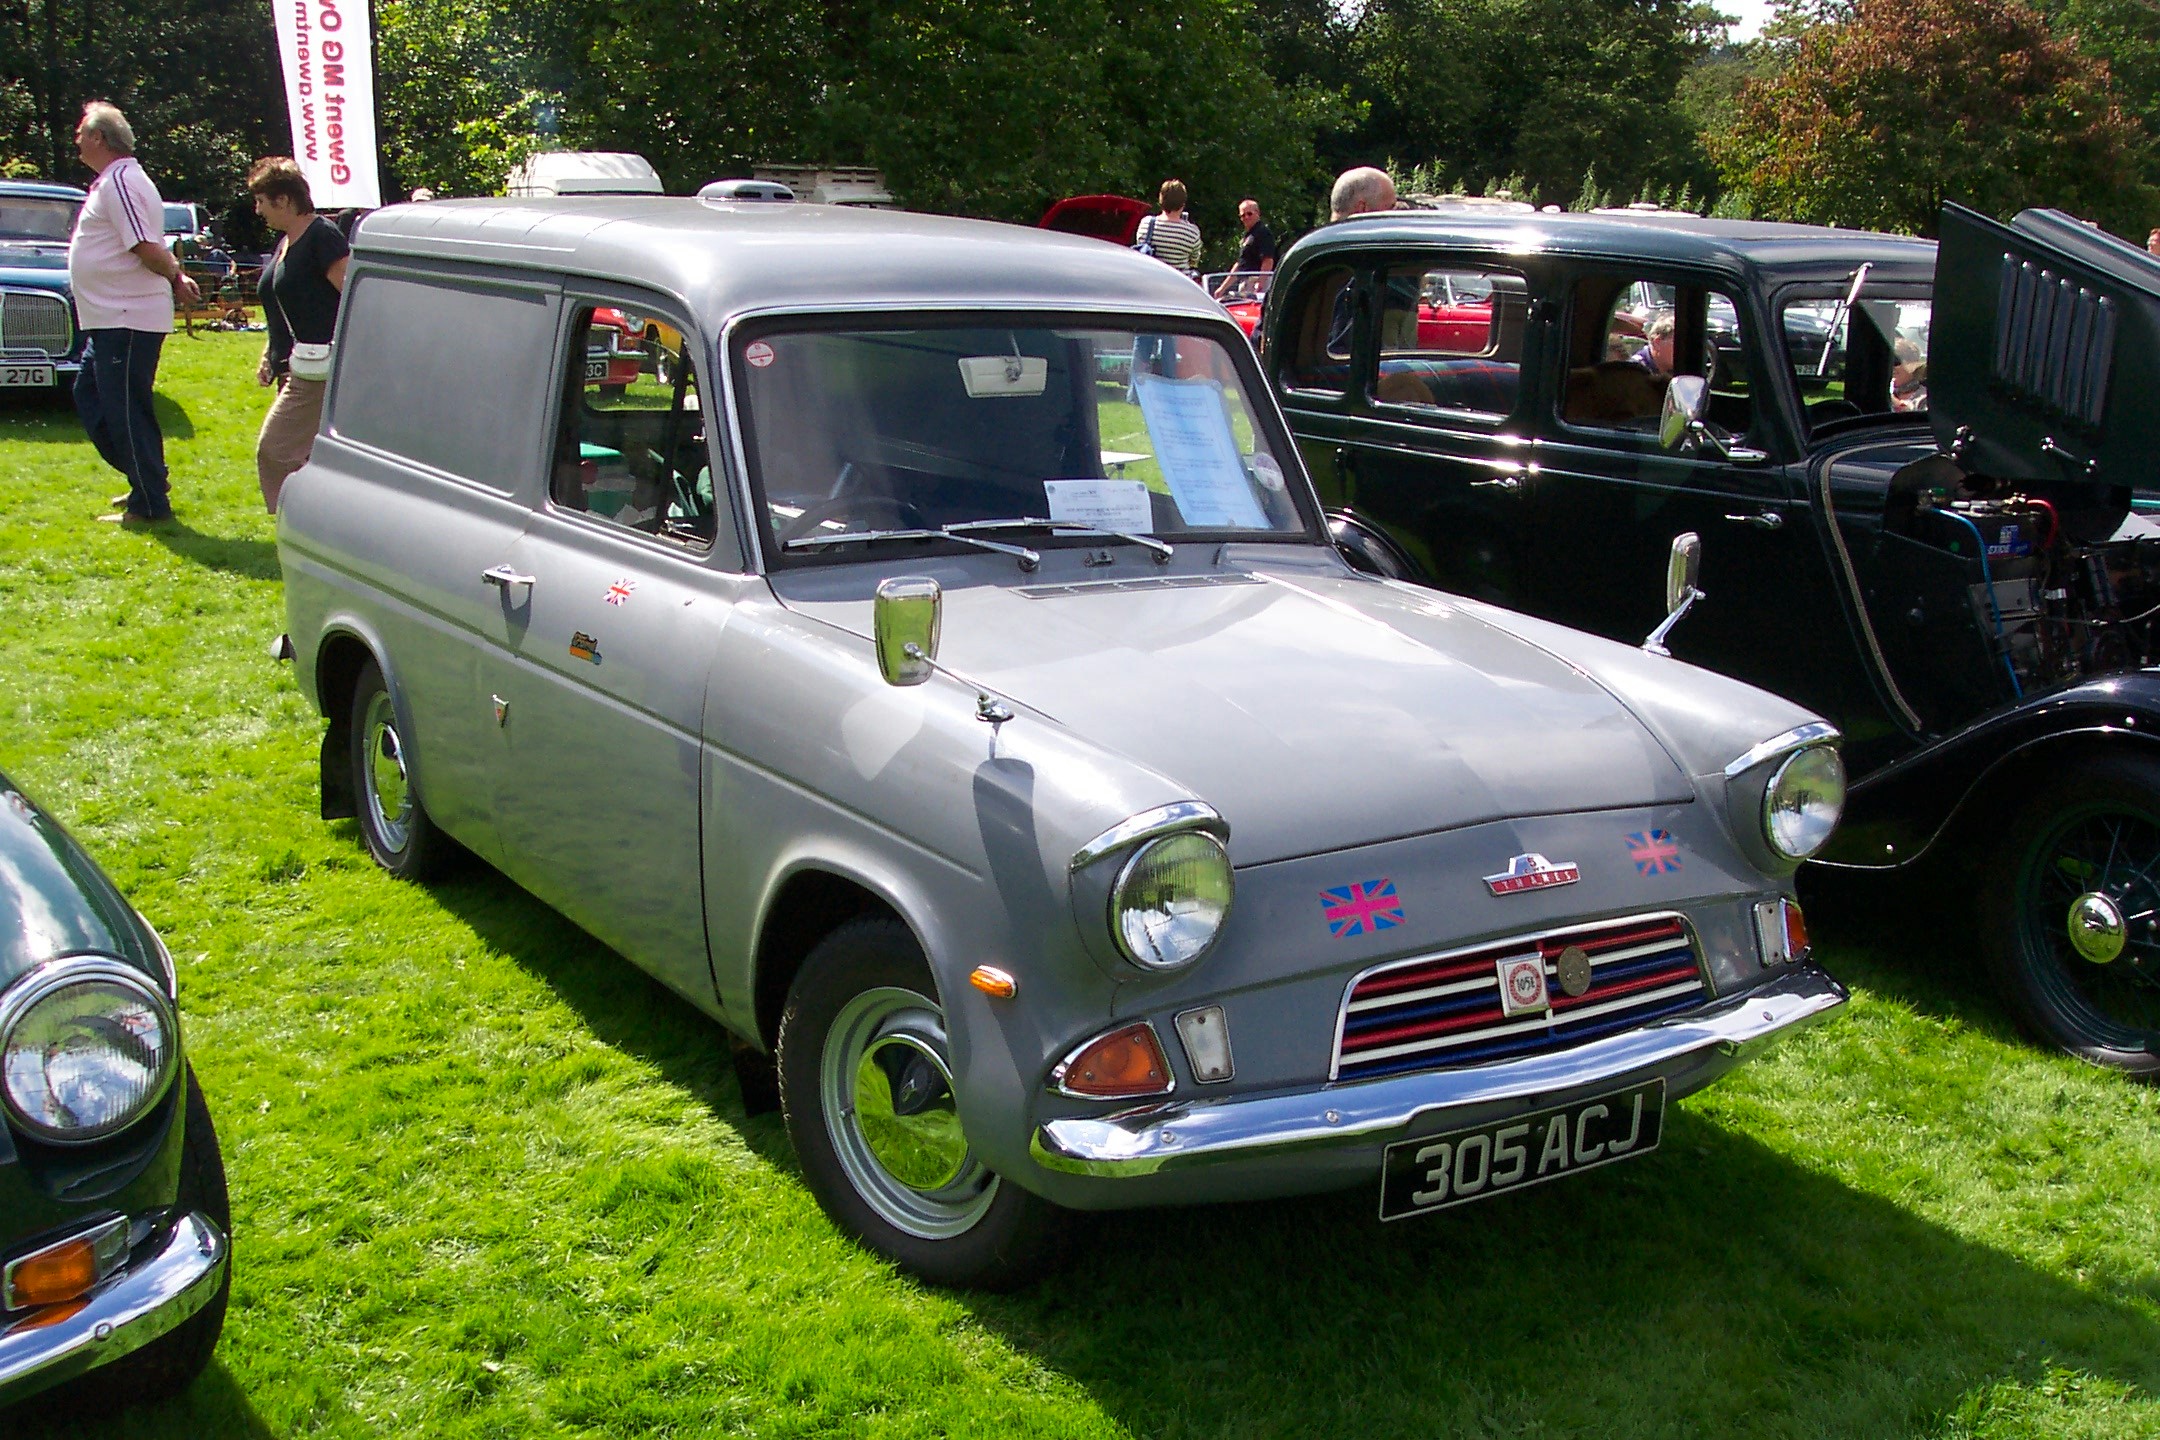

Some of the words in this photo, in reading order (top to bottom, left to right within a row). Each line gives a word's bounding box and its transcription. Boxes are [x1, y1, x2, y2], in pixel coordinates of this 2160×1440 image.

[1503, 870, 1571, 889] THAMES
[1412, 1123, 1530, 1206] 305
[1537, 1093, 1643, 1174] ACJ
